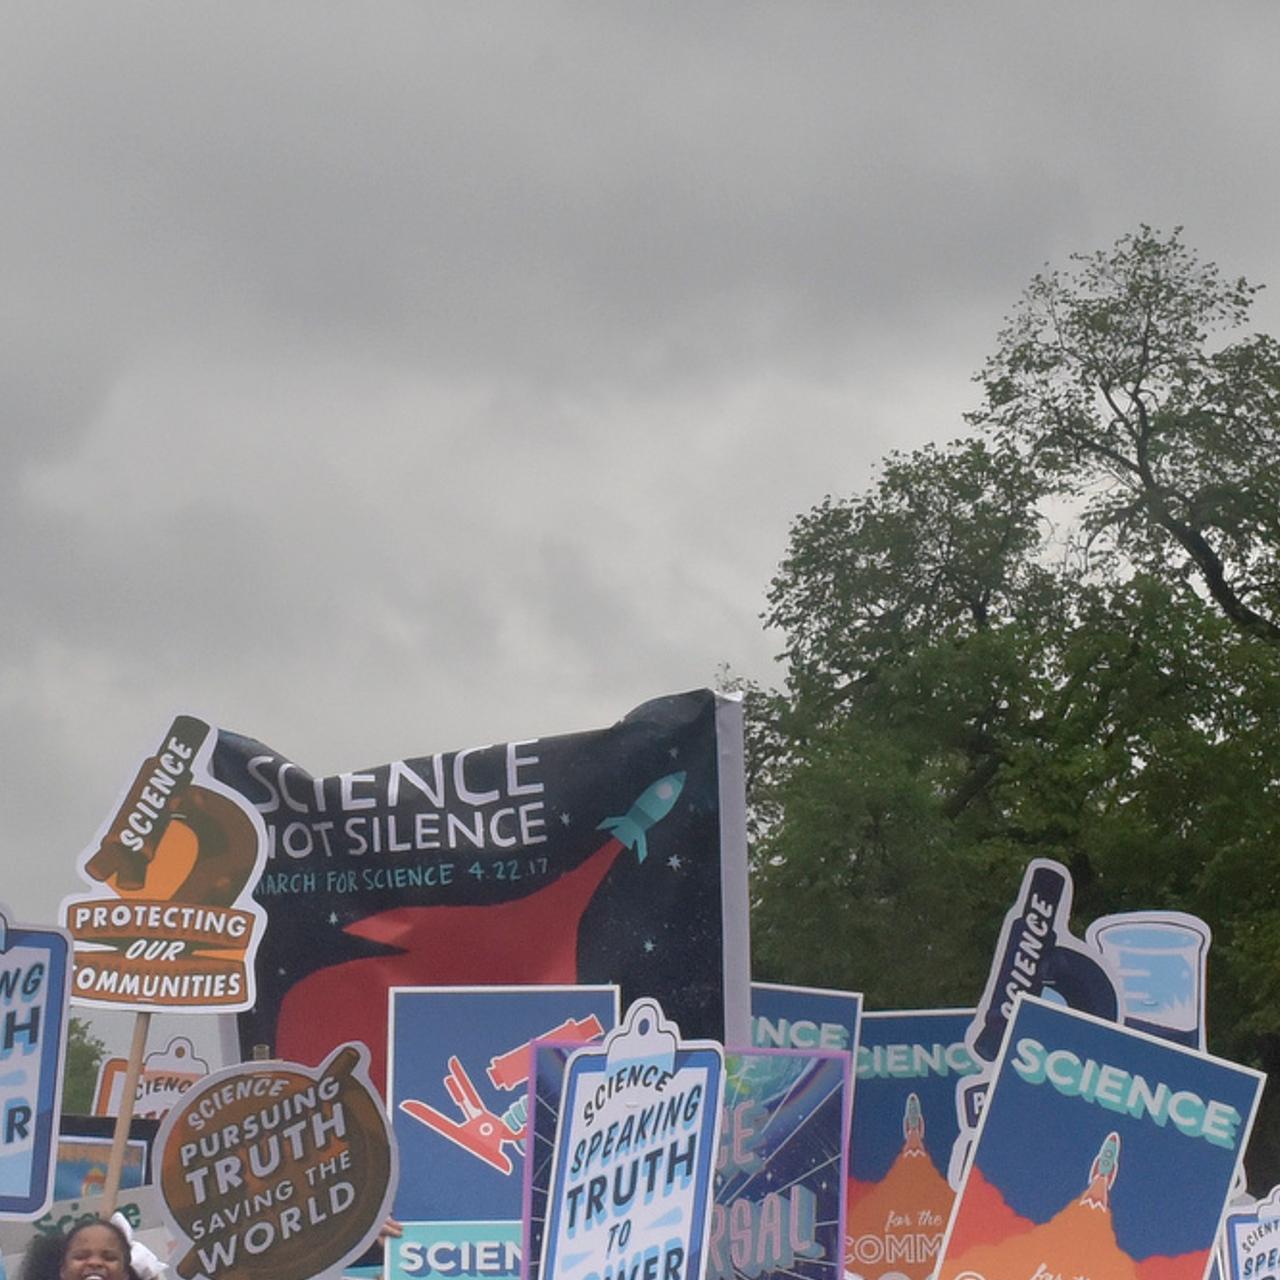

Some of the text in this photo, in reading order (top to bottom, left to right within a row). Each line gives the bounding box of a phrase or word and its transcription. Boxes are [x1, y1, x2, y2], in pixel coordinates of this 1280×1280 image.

[120, 736, 193, 852] SCIENCE
[247, 738, 546, 814] SCIENCE
[349, 802, 548, 856] SILENCE
[327, 868, 358, 894] FOR
[364, 863, 455, 891] SCIENCE
[75, 905, 247, 937] PROTECTING
[125, 939, 186, 961] OUR
[72, 966, 241, 1002] OMMUNITIES
[857, 1042, 971, 1074] CIENC
[187, 1077, 289, 1131] SCIENCE
[583, 1064, 675, 1127] SCIENCE
[1011, 1039, 1234, 1140] SCIENCE
[180, 1074, 340, 1168] PURSUING
[570, 1084, 703, 1175] SPEAKING
[185, 1103, 347, 1206] TRUTH
[566, 1133, 698, 1230] TRUTH
[191, 1180, 294, 1240] SAVING
[306, 1149, 352, 1186] THE
[197, 1181, 355, 1275] WORLD
[398, 1239, 522, 1273] SCIEN
[606, 1219, 632, 1254] TO
[845, 1234, 944, 1264] COMM
